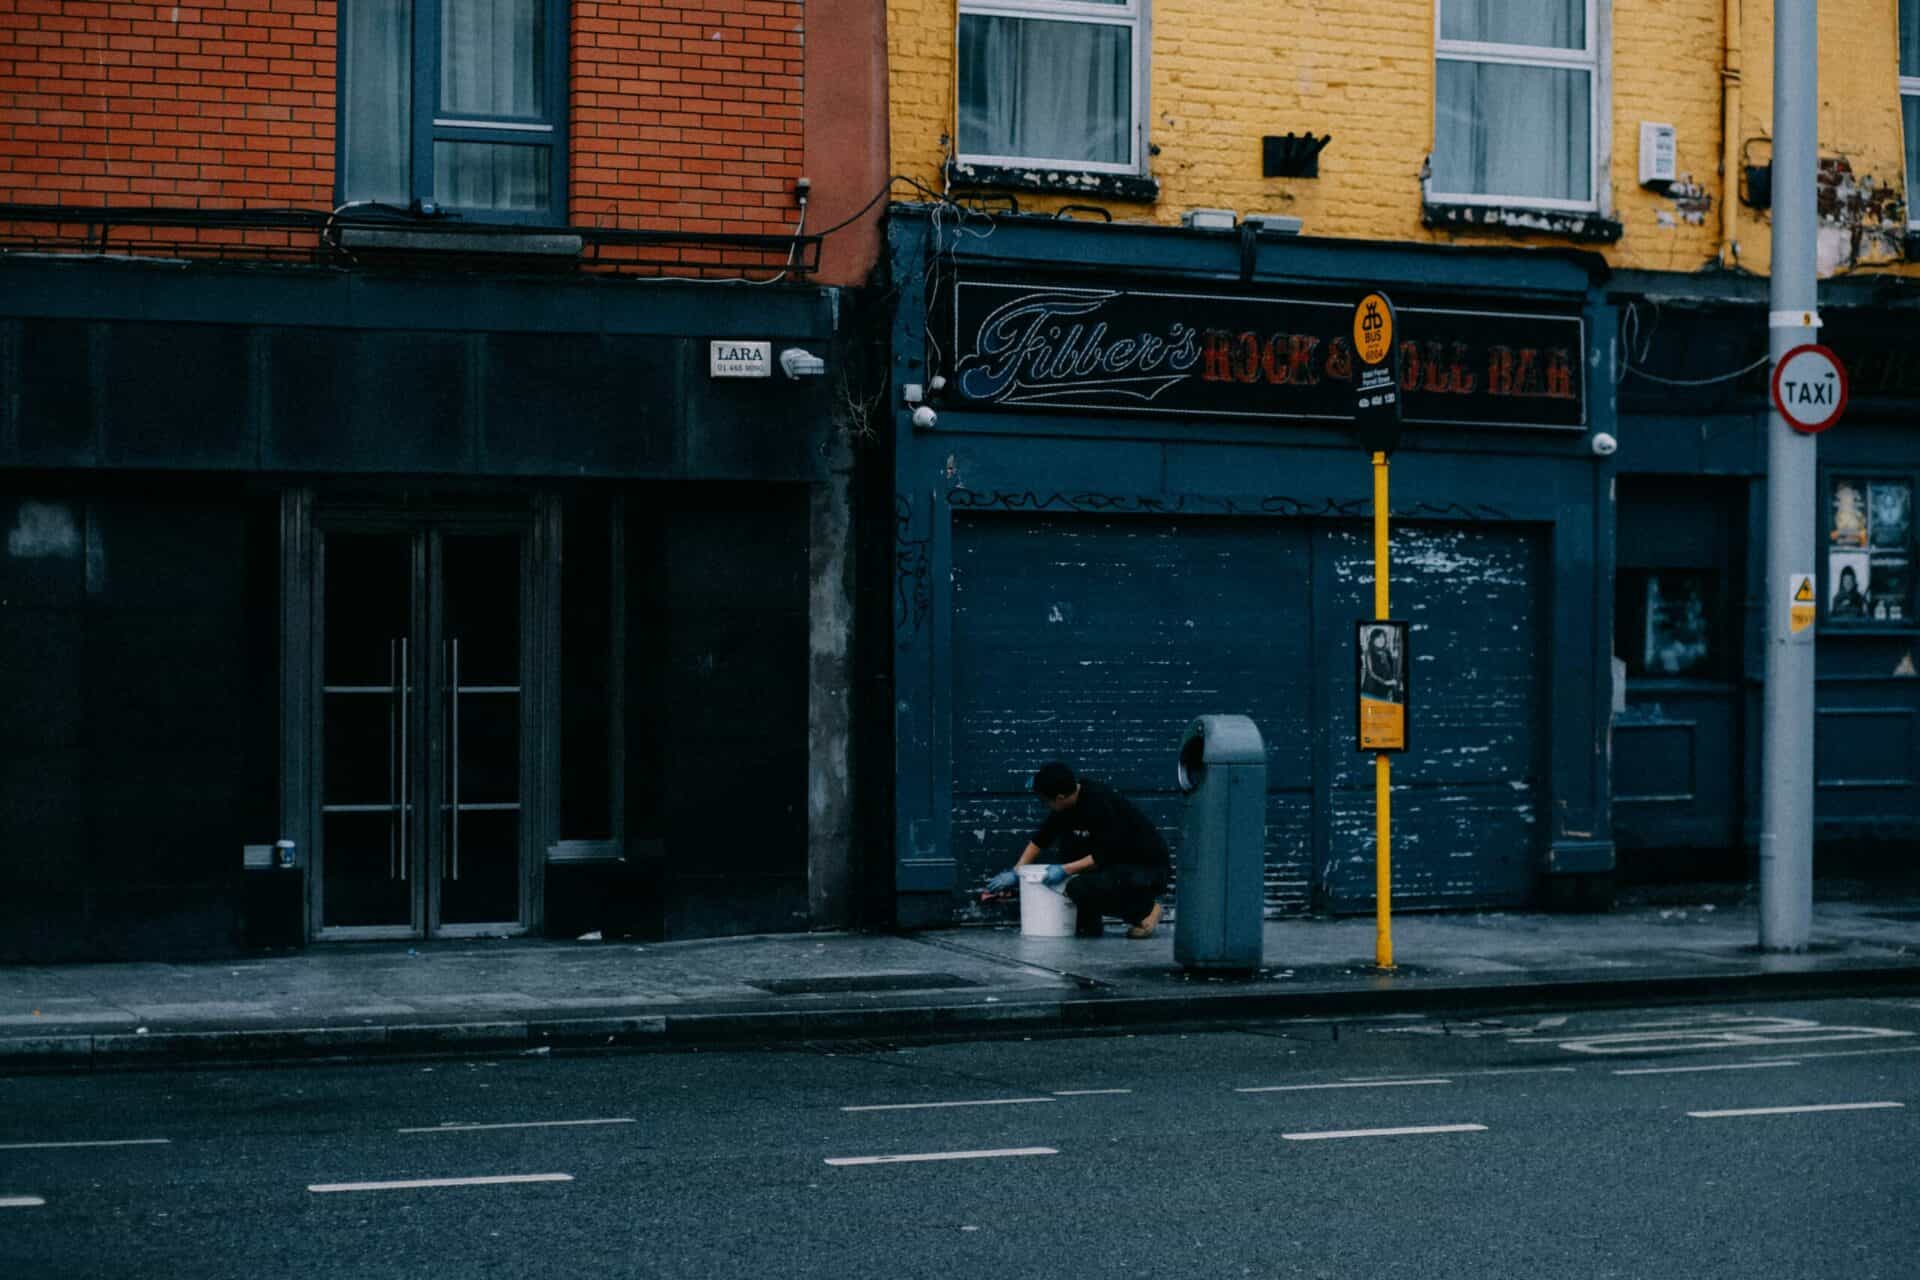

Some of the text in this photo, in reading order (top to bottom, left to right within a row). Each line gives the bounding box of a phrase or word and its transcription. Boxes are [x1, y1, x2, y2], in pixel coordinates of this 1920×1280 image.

[959, 291, 1203, 402] Fibber's
[1201, 329, 1320, 385] ROCK
[1400, 339, 1475, 396] OLL
[1365, 331, 1382, 344] BUS
[718, 347, 762, 360] LARA
[1784, 381, 1834, 405] TAXI
